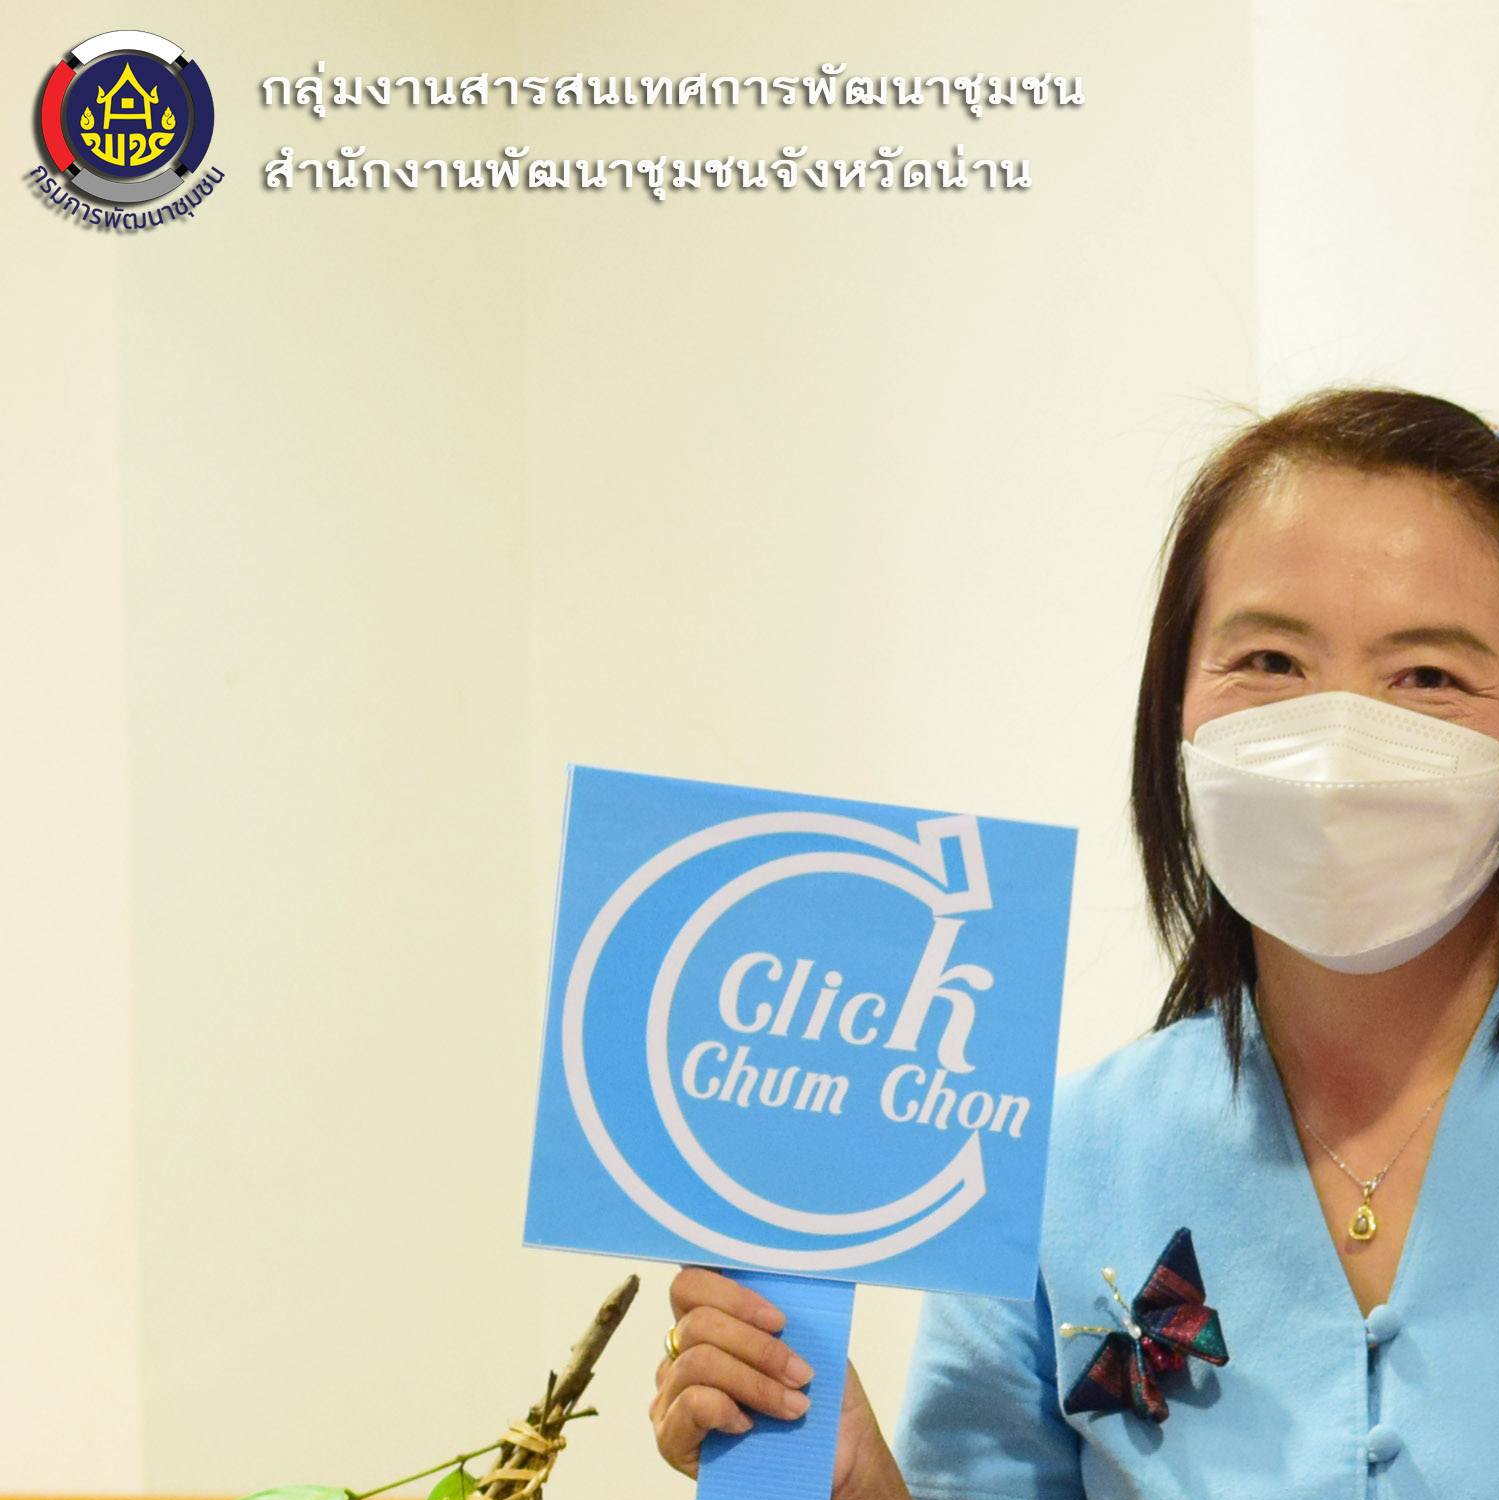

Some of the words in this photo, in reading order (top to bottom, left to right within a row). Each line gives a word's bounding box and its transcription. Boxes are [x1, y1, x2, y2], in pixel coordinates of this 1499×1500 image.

[718, 916, 994, 1074] Click
[682, 1041, 849, 1115] Chum
[880, 1064, 1031, 1138] Chon
